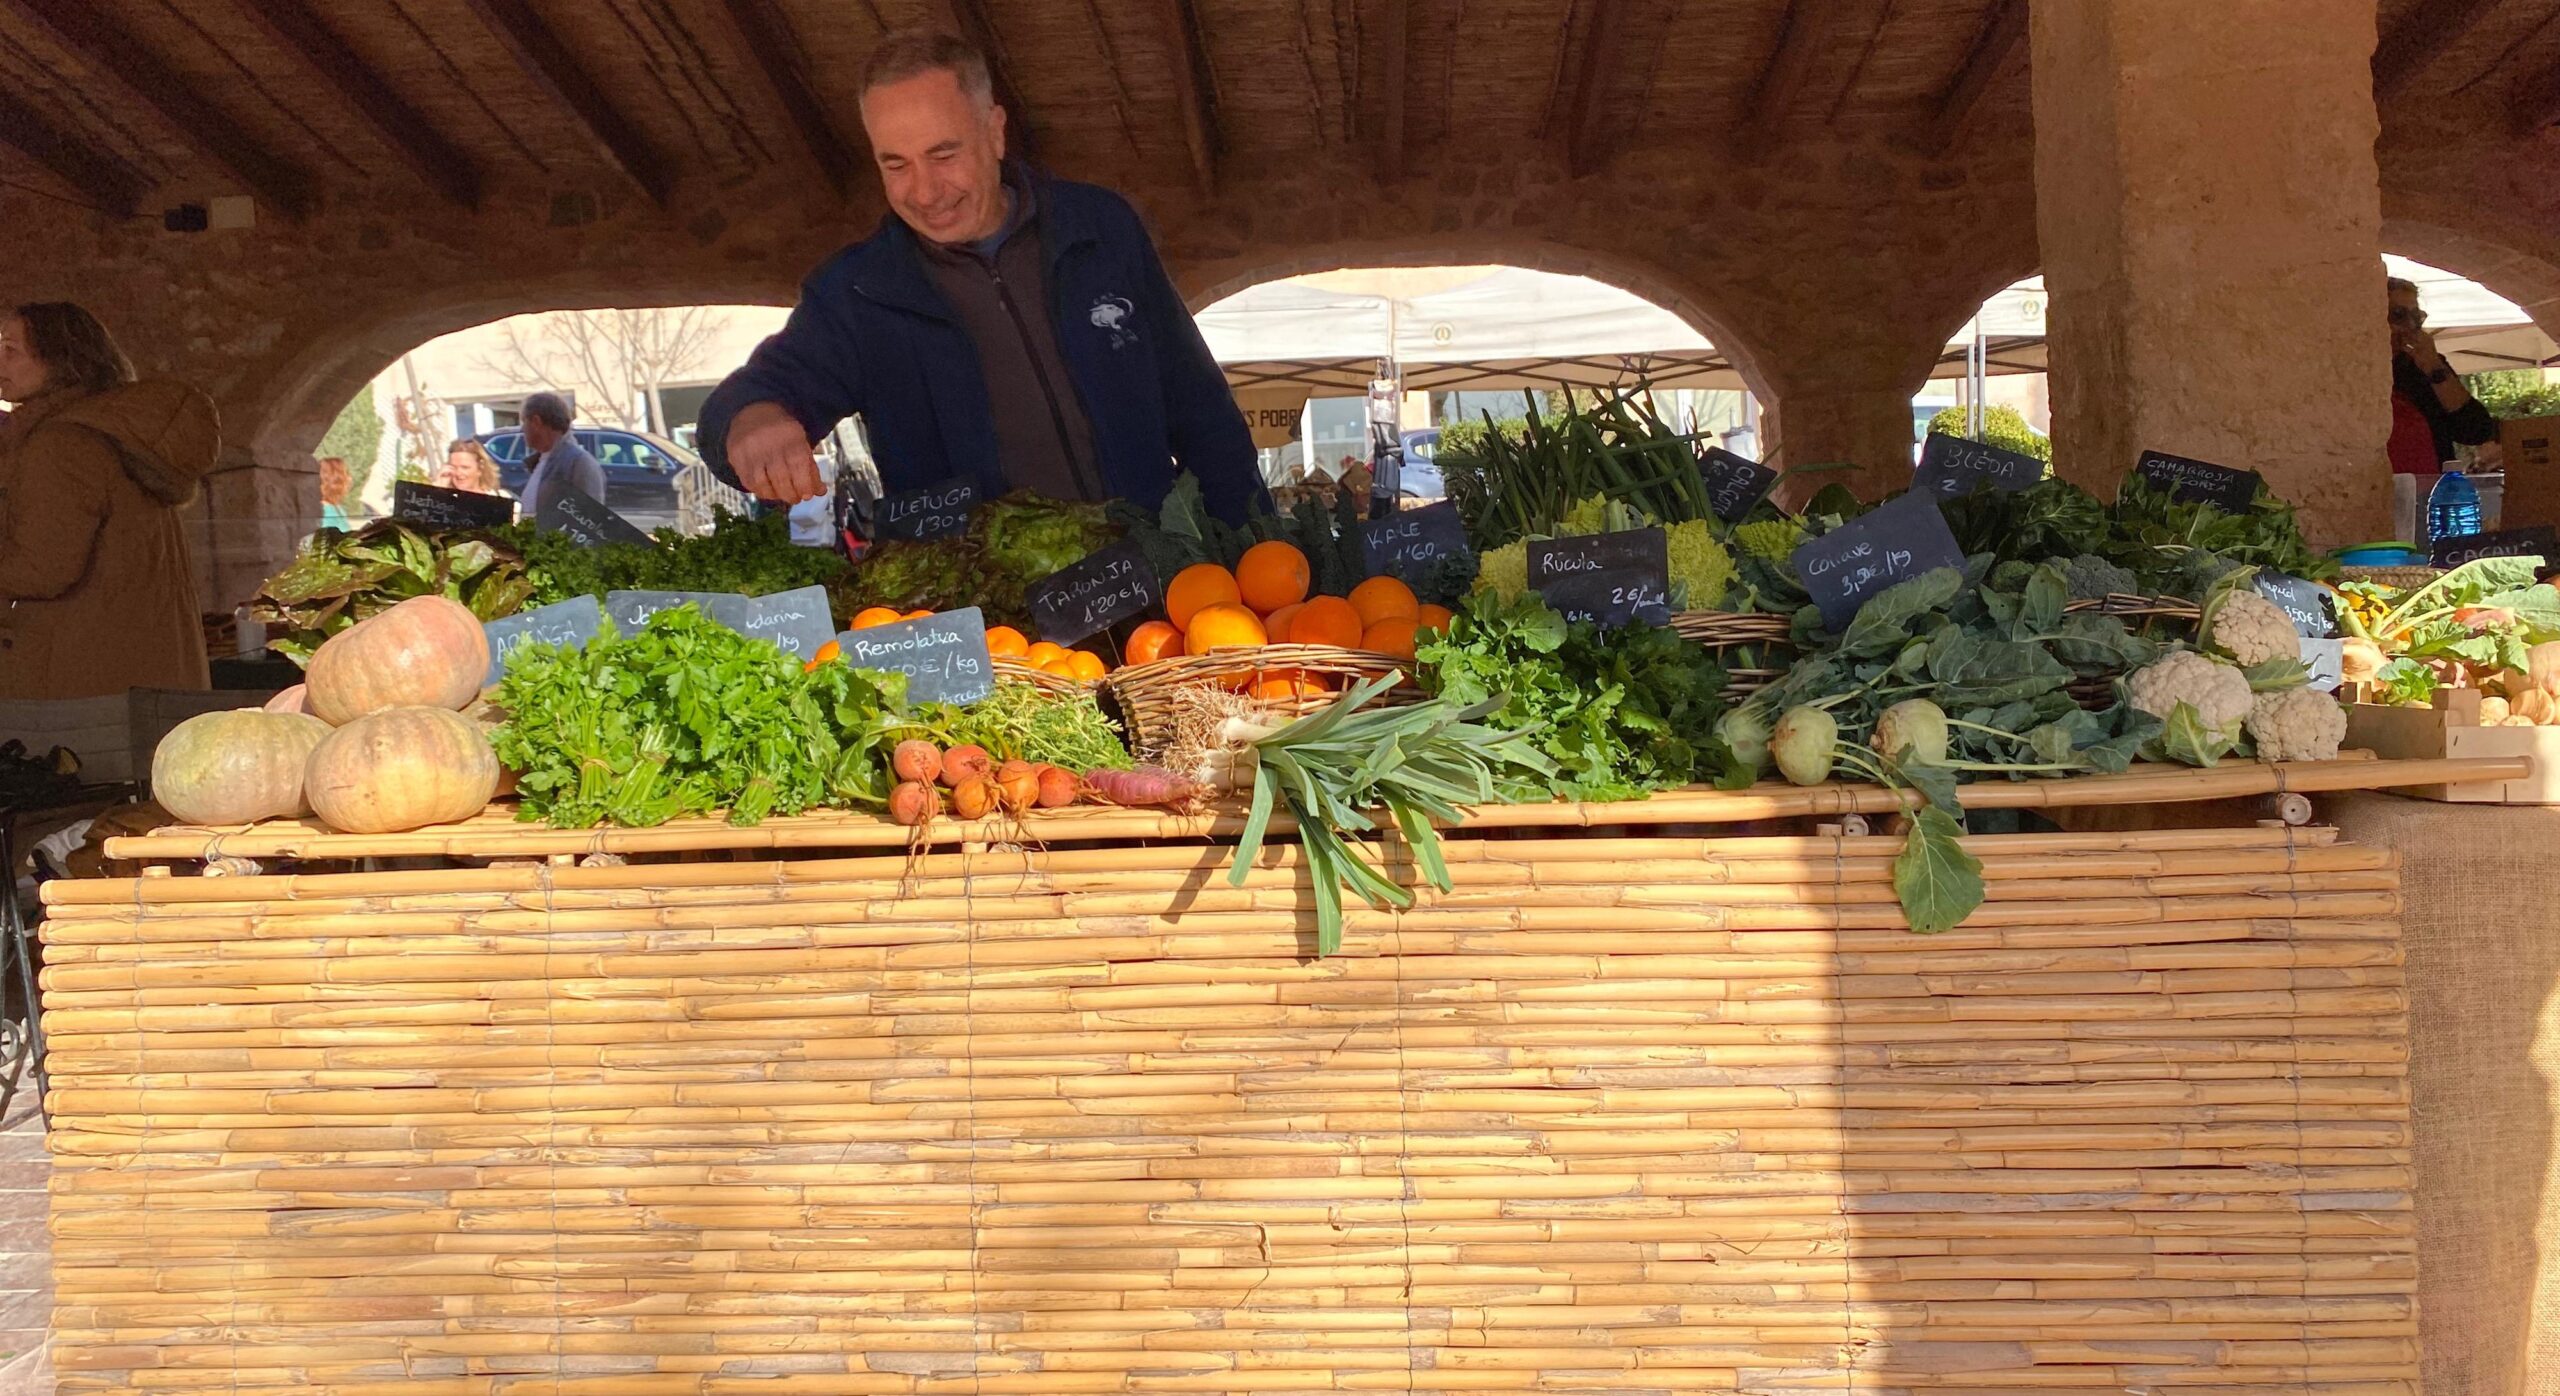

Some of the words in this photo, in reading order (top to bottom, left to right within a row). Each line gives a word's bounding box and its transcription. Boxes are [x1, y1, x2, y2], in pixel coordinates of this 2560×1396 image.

[889, 486, 972, 522] LLETUGA
[1366, 522, 1421, 550] KALE
[1037, 559, 1133, 613] TARONJA
[854, 627, 963, 662] Remolatxa
